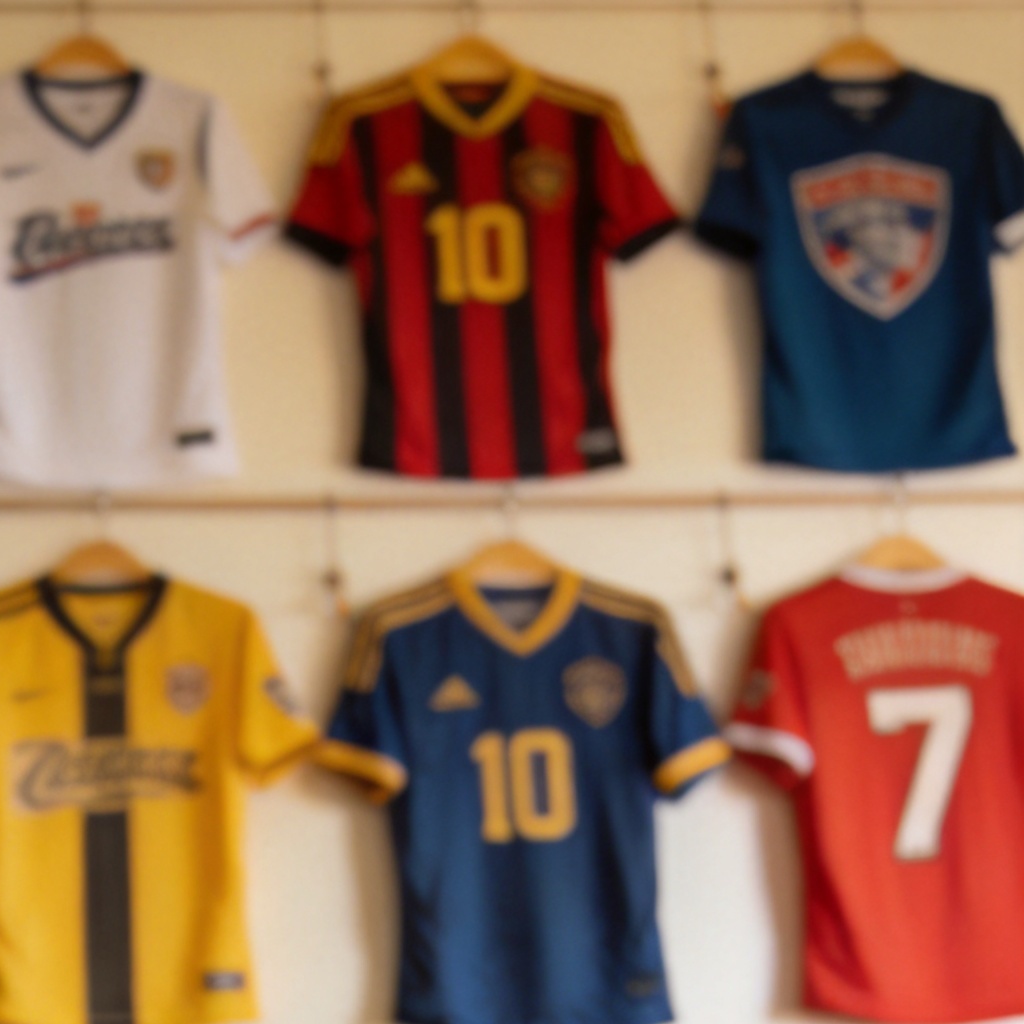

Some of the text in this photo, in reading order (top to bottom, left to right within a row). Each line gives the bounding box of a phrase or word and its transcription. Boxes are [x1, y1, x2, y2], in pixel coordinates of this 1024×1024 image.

[426, 203, 527, 304] 10
[470, 728, 576, 842] 10
[865, 685, 974, 862] 7
